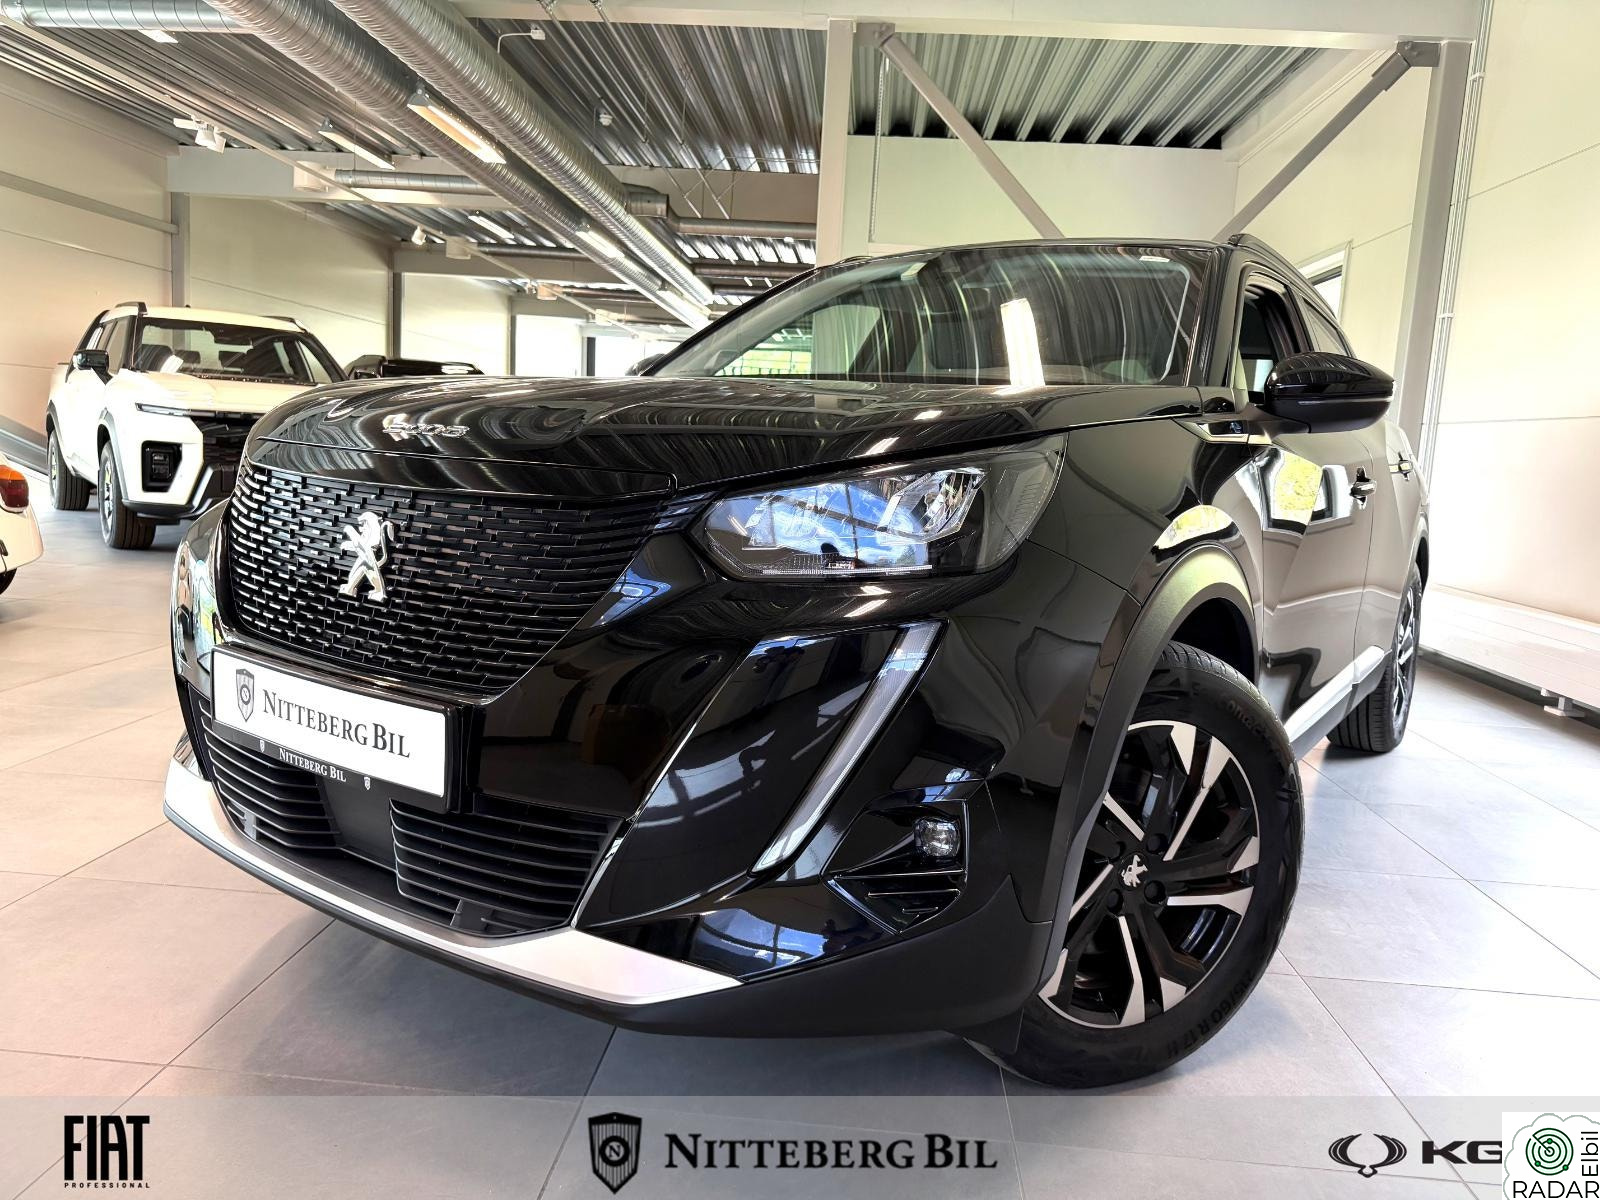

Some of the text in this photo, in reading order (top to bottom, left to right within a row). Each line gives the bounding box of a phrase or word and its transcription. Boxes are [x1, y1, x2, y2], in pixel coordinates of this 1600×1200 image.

[263, 688, 411, 758] NITTEBERG BIL
[279, 748, 347, 782] NITTEBERG BIL
